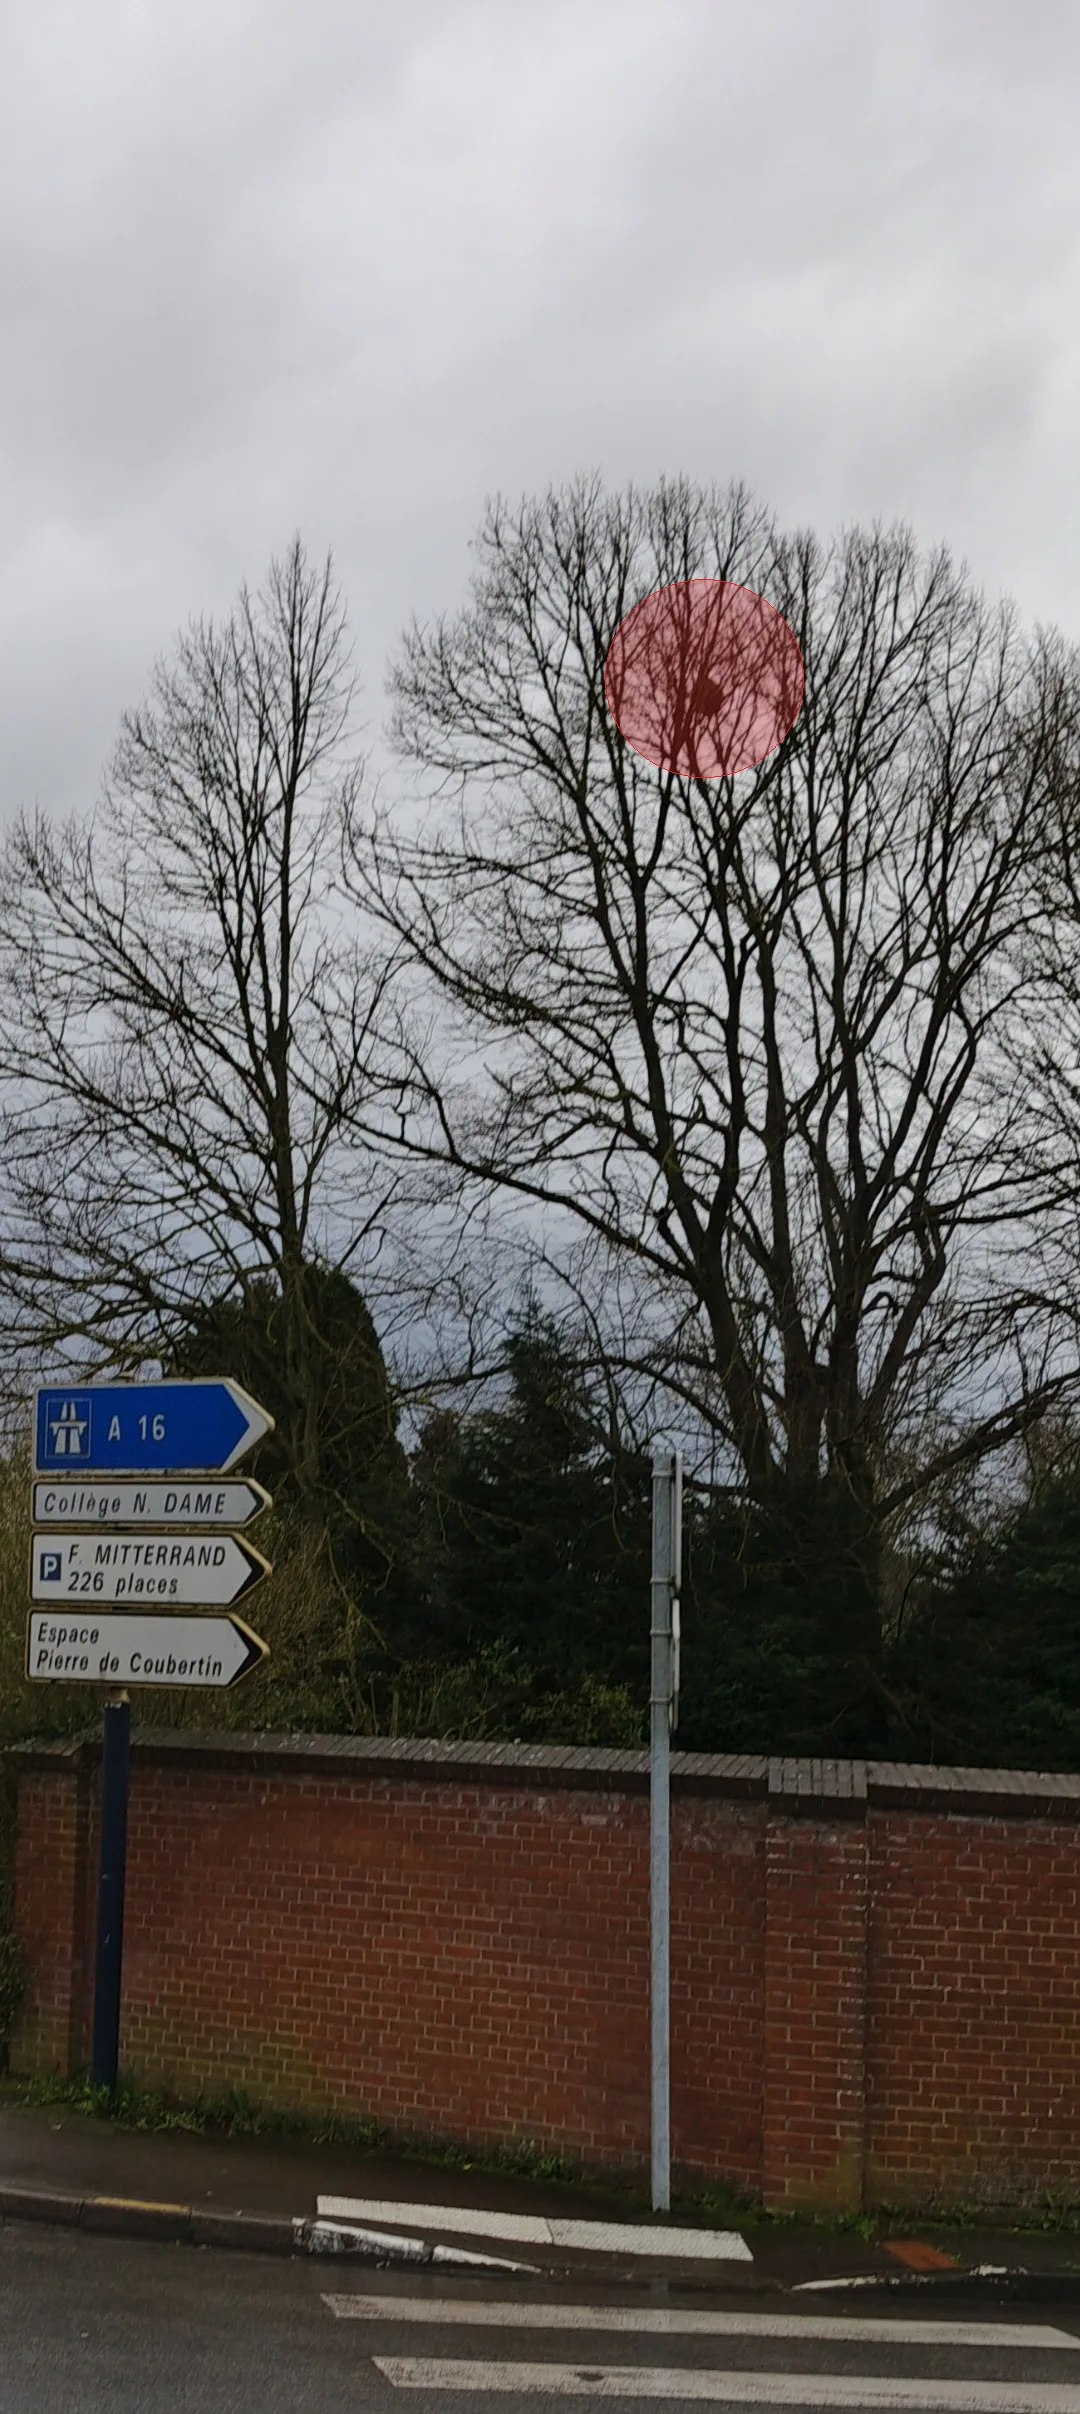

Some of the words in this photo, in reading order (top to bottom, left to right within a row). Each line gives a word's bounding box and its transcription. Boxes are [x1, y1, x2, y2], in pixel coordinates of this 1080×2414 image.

[107, 1414, 121, 1441] A
[138, 1414, 166, 1441] 16
[44, 1492, 121, 1519] Collège
[132, 1493, 151, 1515] N.
[163, 1492, 226, 1515] DAME
[68, 1543, 83, 1566] F.
[94, 1543, 226, 1567] MITTERRAND
[67, 1571, 104, 1592] 226
[115, 1573, 179, 1597] places
[36, 1622, 100, 1648] Espace
[36, 1649, 89, 1672] Pierre
[99, 1651, 120, 1673] de
[129, 1652, 223, 1678] Coubertin
